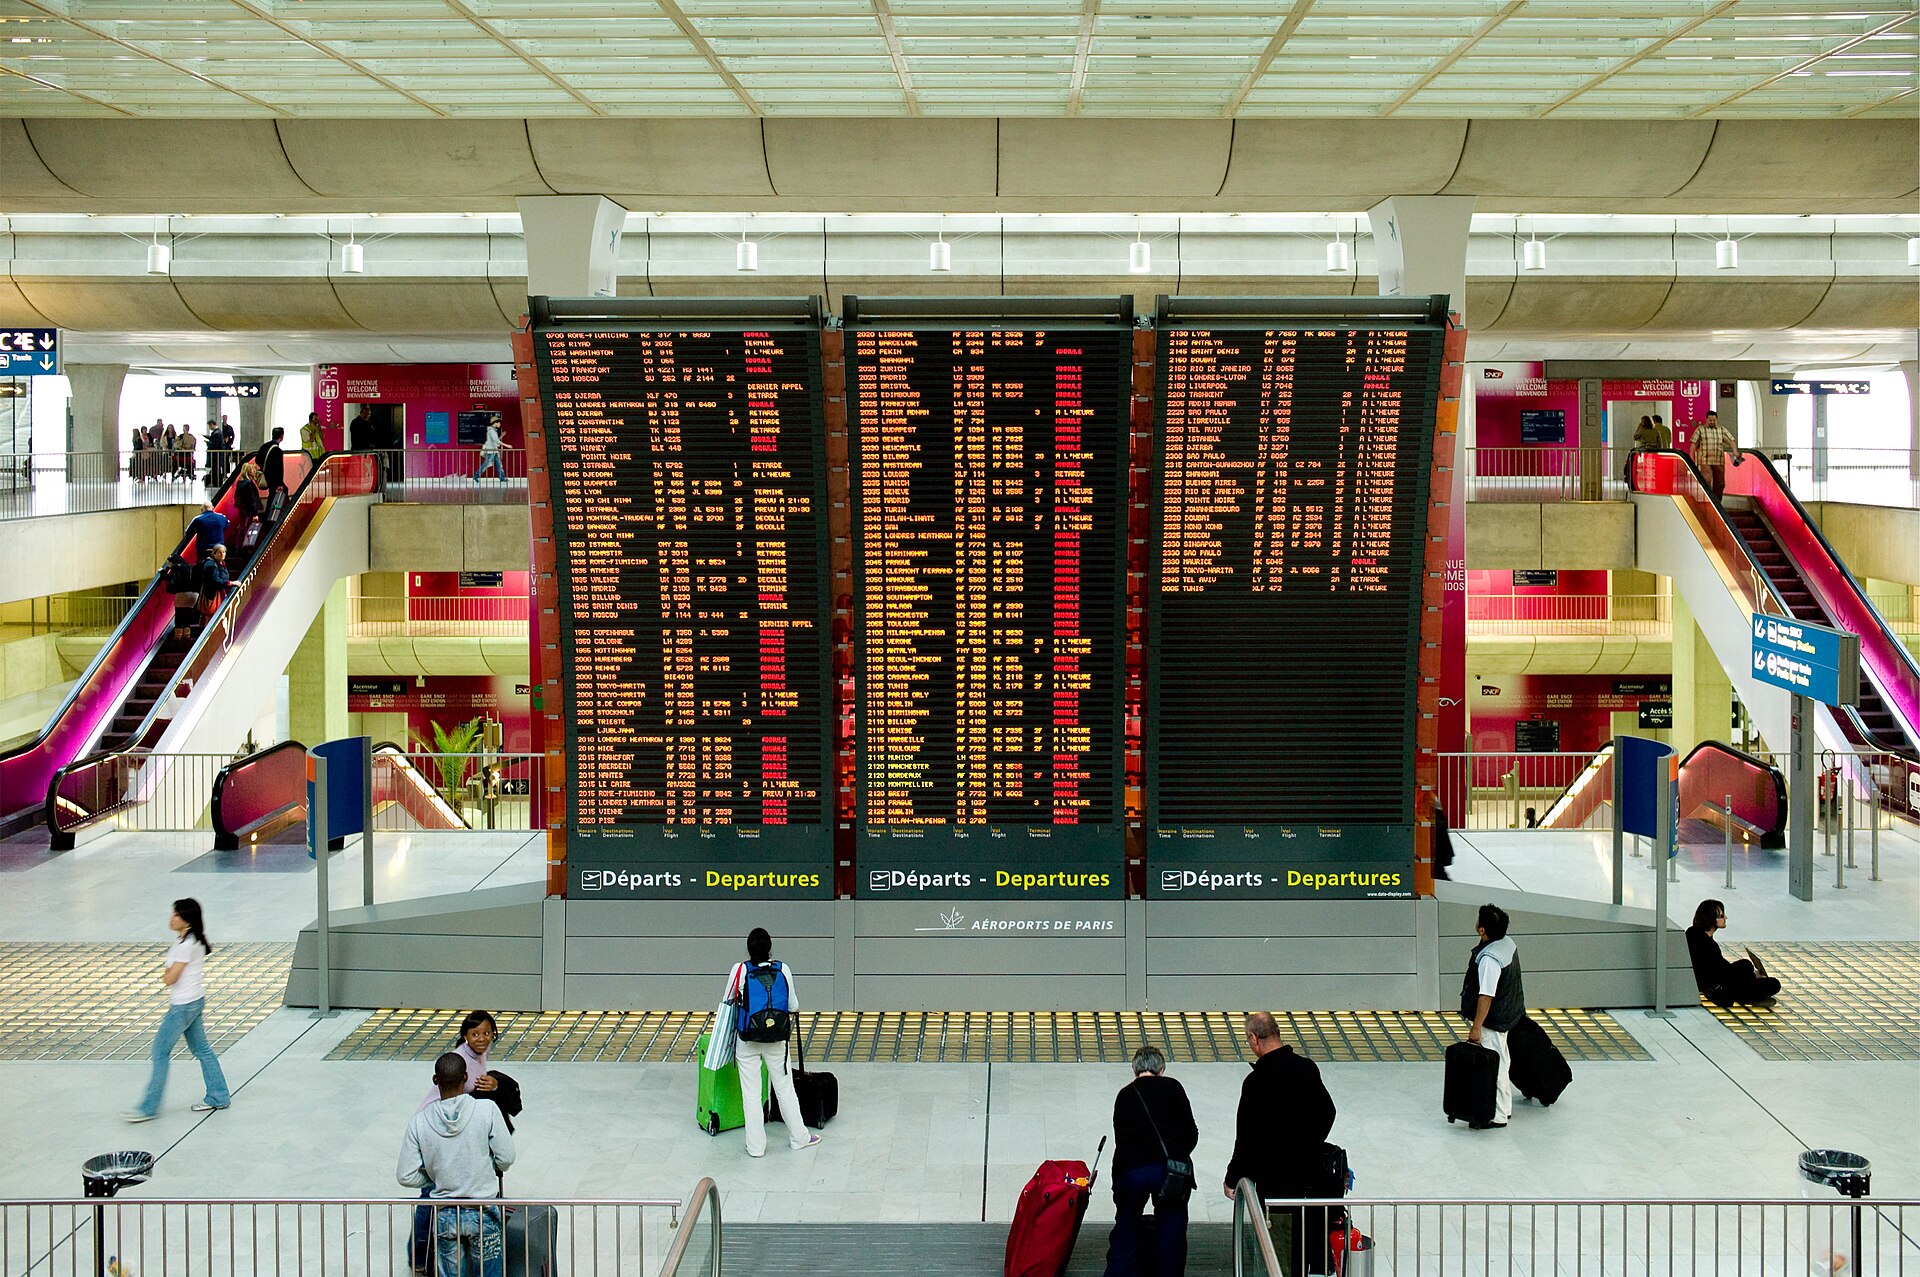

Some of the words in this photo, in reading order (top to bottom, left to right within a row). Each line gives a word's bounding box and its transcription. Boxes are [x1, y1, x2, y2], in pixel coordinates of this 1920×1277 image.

[603, 870, 681, 890] Départs
[706, 870, 819, 891] Departures
[891, 870, 970, 890] Départs
[996, 870, 1110, 891] Departures
[1183, 870, 1262, 890] Départs
[1287, 870, 1401, 890] Departures
[972, 919, 1049, 930] AÉROPORTS
[1054, 921, 1071, 930] DE
[1075, 920, 1114, 930] PARIS
